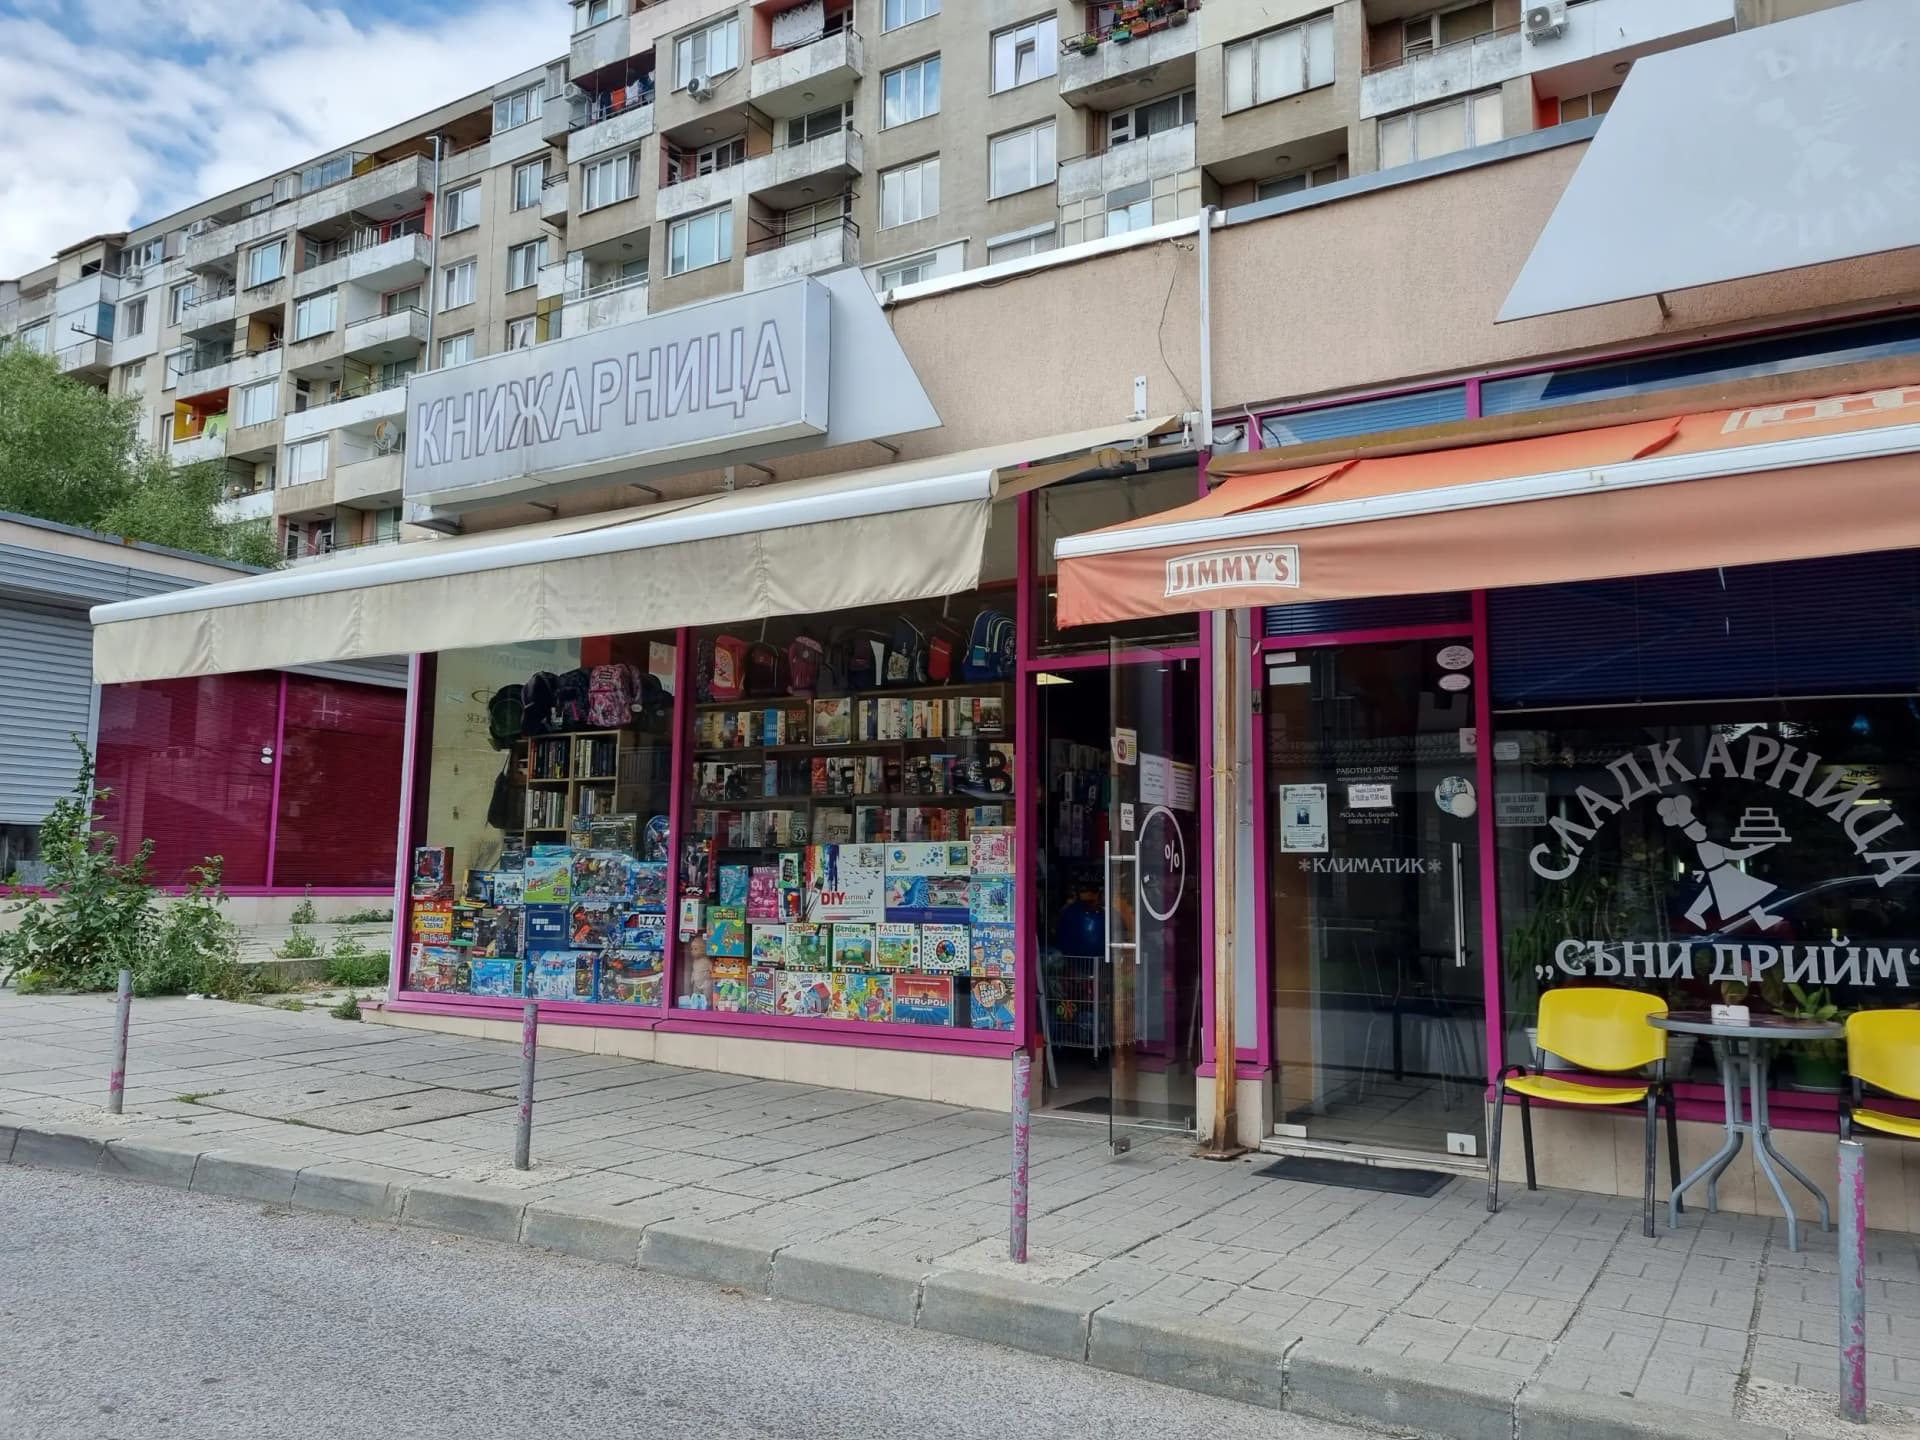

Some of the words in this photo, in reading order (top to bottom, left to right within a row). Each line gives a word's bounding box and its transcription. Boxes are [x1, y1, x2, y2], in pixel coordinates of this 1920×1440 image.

[415, 319, 791, 470] КНИЖАРНИЦА
[1172, 551, 1290, 591] JIMMY'S
[1529, 733, 1920, 888] СЛАДКАРНИЦА
[1312, 857, 1426, 874] КЛИМАТИК
[820, 892, 846, 906] DIY
[1535, 939, 1695, 981] „СЪНИ
